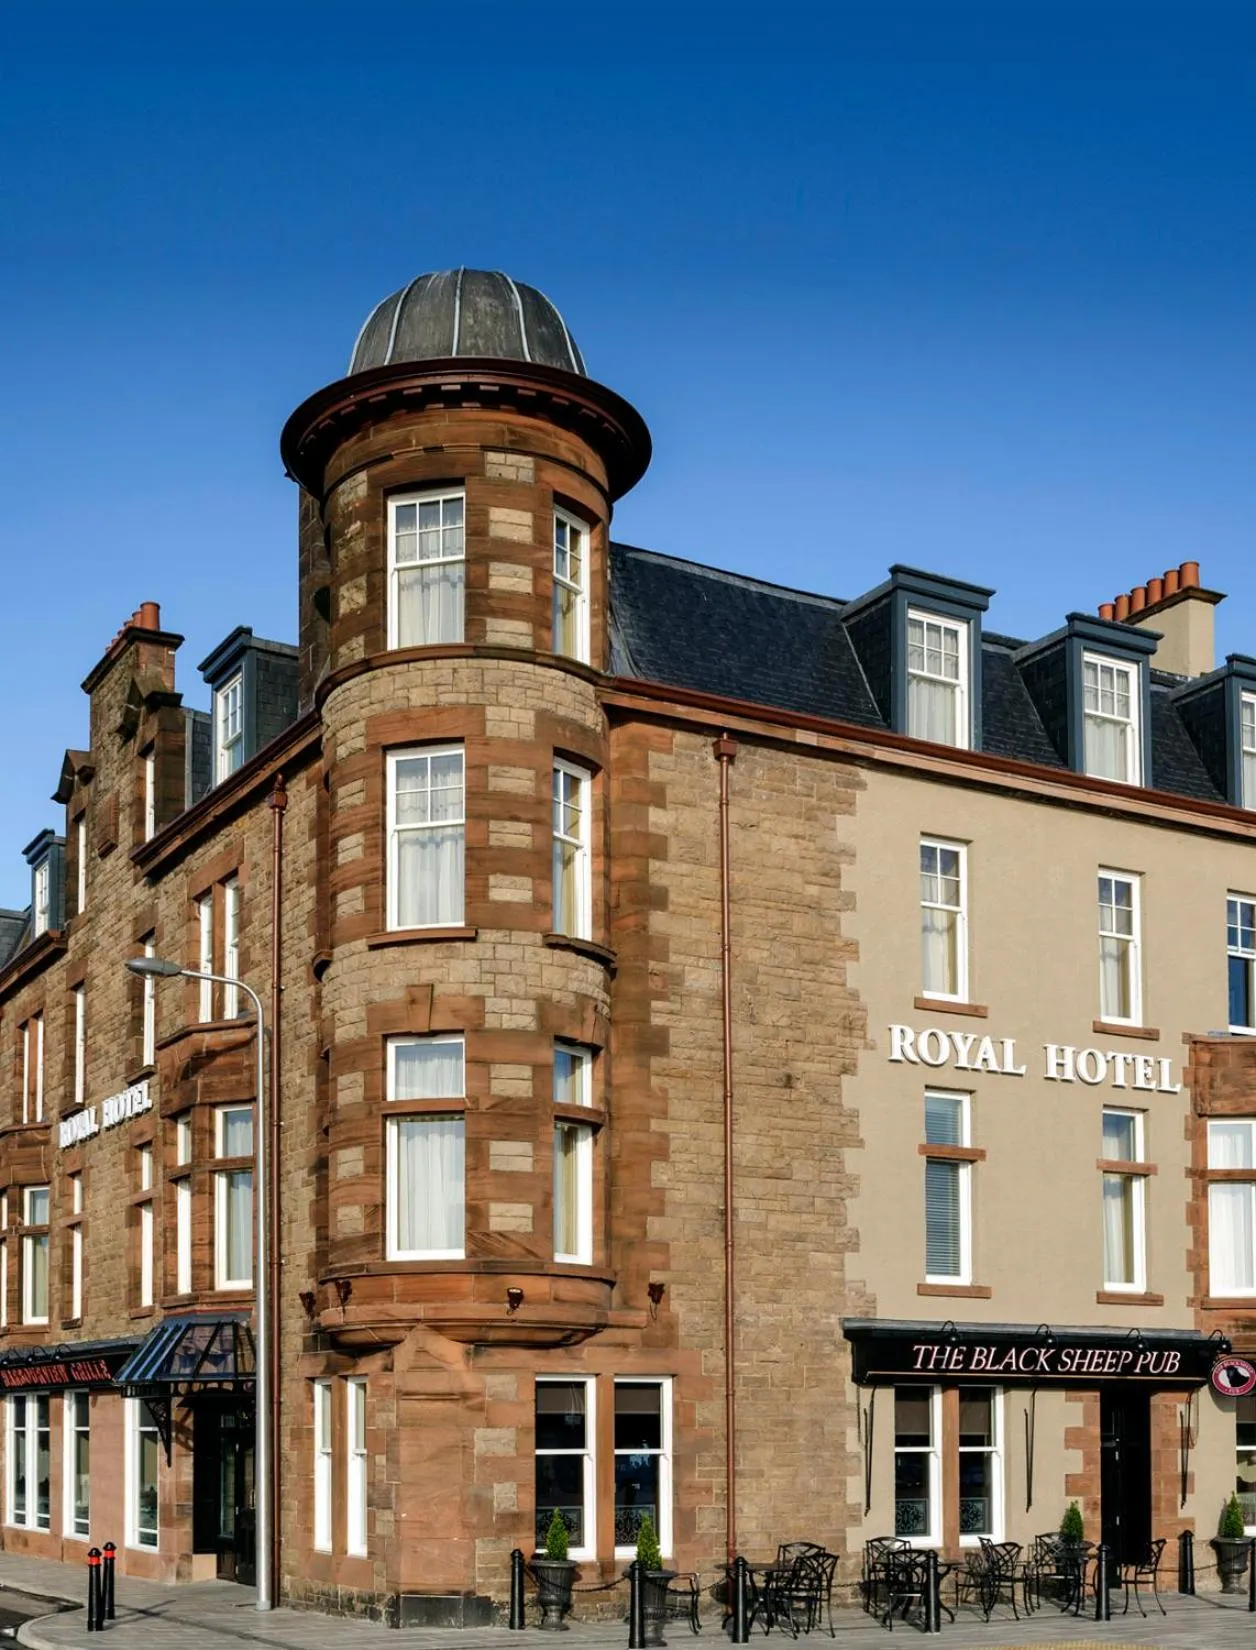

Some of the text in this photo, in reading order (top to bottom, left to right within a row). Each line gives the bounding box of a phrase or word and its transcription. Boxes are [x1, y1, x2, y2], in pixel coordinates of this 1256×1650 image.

[888, 1024, 1182, 1094] ROYAL HOTEL
[102, 1079, 153, 1130] HOTEL
[912, 1344, 1181, 1374] THE BLACK SHEEP PUB
